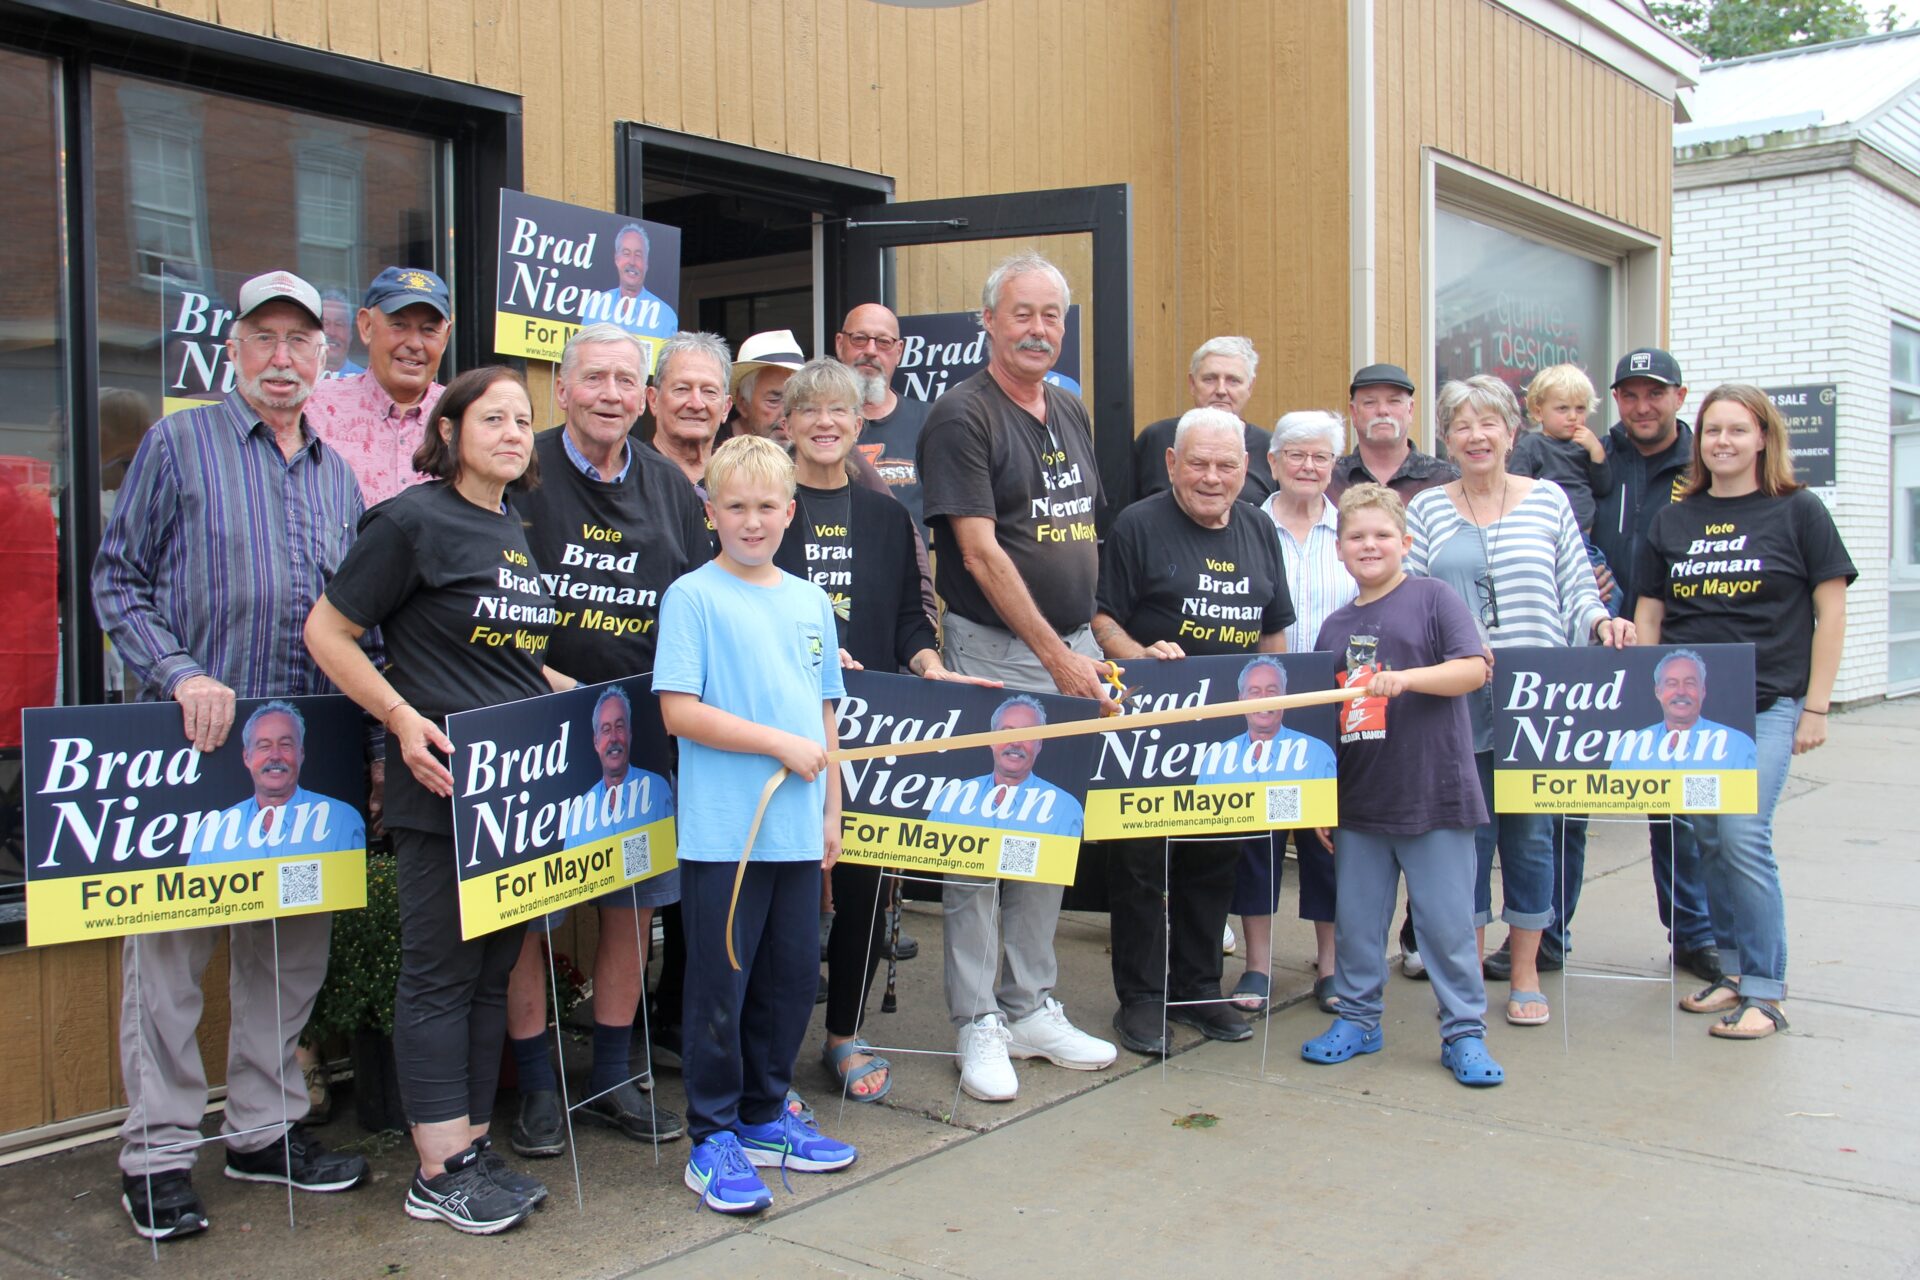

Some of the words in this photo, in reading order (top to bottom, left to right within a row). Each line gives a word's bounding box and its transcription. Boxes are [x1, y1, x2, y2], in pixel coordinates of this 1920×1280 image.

[507, 217, 597, 270] Brad
[504, 261, 661, 329] Nieman
[172, 292, 235, 337] Br
[525, 320, 558, 344] For
[898, 331, 986, 368] Brad
[1778, 393, 1808, 406] SALE
[1031, 496, 1092, 519] Nema
[582, 523, 623, 543] Vote
[815, 524, 847, 537] Vote
[1037, 524, 1067, 542] For
[1070, 522, 1097, 543] May
[1705, 523, 1735, 535] Vote
[504, 550, 528, 567] Vote
[560, 543, 639, 574] Brad
[1687, 535, 1747, 555] Brad
[807, 566, 851, 586] iem
[1205, 558, 1235, 572] Vote
[1671, 559, 1761, 578] Nieman
[498, 567, 541, 596] Brad
[1198, 573, 1250, 595] Brad
[1673, 583, 1698, 598] For
[1703, 579, 1762, 597] Mayor
[473, 596, 556, 624] Nieman
[554, 611, 576, 627] or
[580, 608, 654, 636] Mayor
[1181, 597, 1263, 620] Nieman
[470, 625, 512, 647] For
[515, 630, 550, 655] Mayor
[1179, 620, 1215, 640] For
[1219, 625, 1260, 648] Mayor
[1502, 669, 1626, 711] Brad
[835, 696, 962, 753] Brad
[1503, 715, 1728, 763] Nieman
[36, 737, 202, 794] Brad
[461, 720, 571, 798] Brad
[1090, 729, 1308, 781] Nieman
[1532, 773, 1577, 795] For
[1586, 773, 1671, 800] Mayor
[1120, 792, 1165, 815] For
[1174, 789, 1255, 816] Mayor
[1534, 799, 1670, 811] www.bradniemancampaign.com
[37, 795, 331, 869] Nieman
[465, 775, 652, 868] Nieman
[1122, 815, 1255, 830] www.bradniemancampaign.com
[841, 815, 889, 844] For
[898, 822, 990, 857] Mayor
[495, 870, 537, 903] For
[544, 846, 614, 888] Mayor
[81, 879, 144, 911] For
[157, 869, 265, 904] Mayor
[499, 874, 615, 920] www.bradniemancampaign.com
[84, 898, 265, 929] www.bradniemancampaign.com
